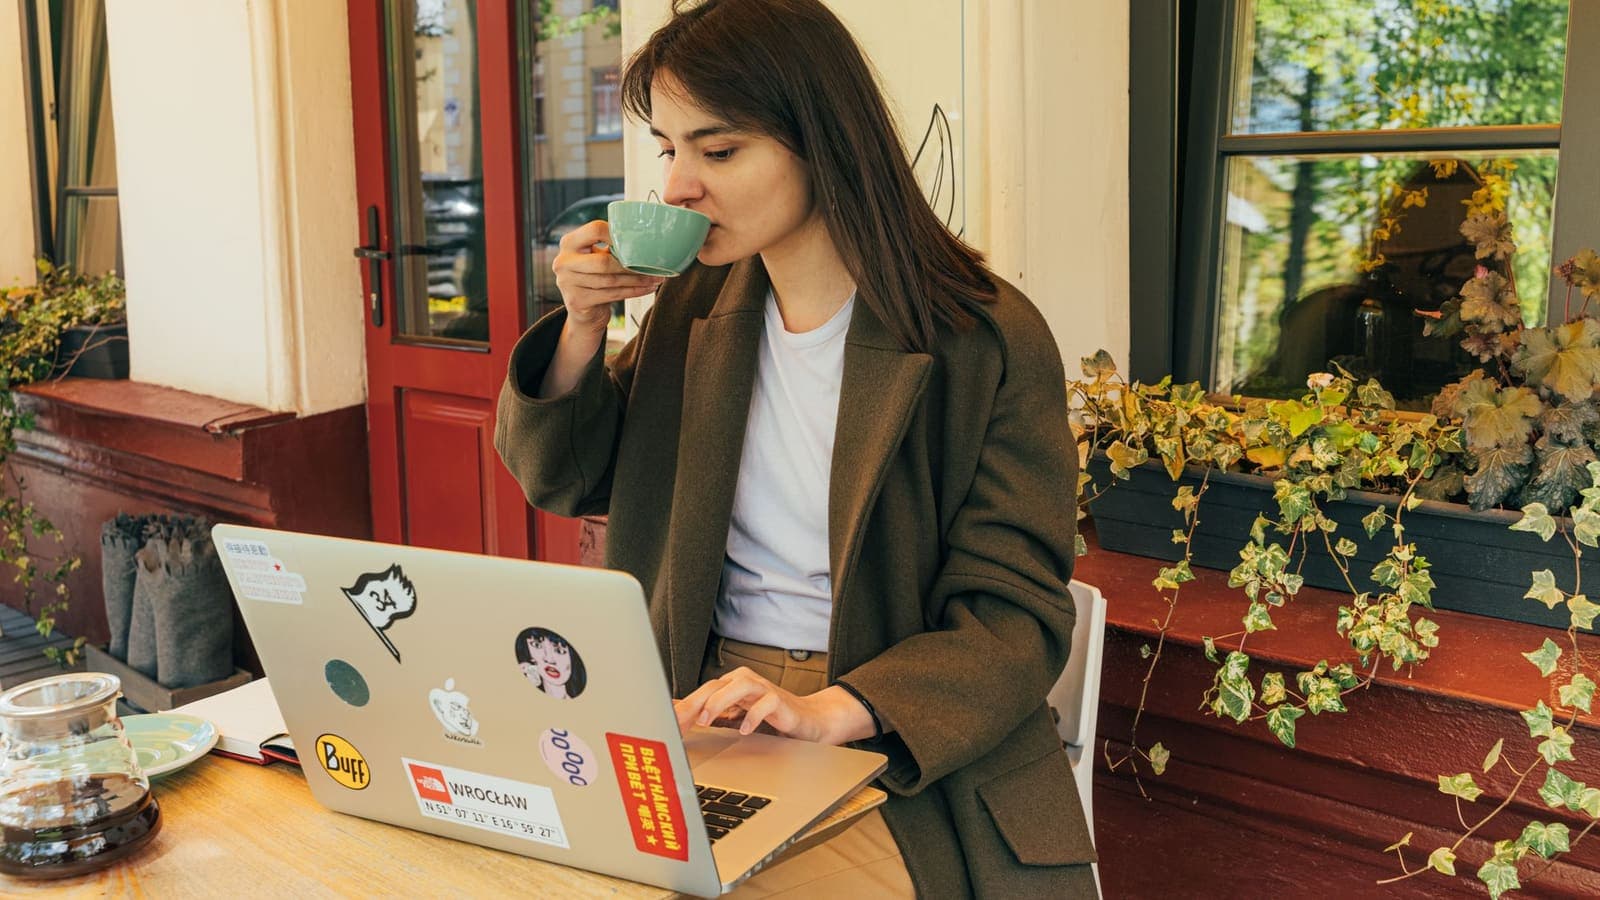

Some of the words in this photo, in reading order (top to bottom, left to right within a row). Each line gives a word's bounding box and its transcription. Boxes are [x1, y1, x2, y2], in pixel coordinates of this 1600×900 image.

[449, 782, 528, 810] WROCŁAW
[425, 802, 434, 812] N
[492, 816, 499, 826] E
